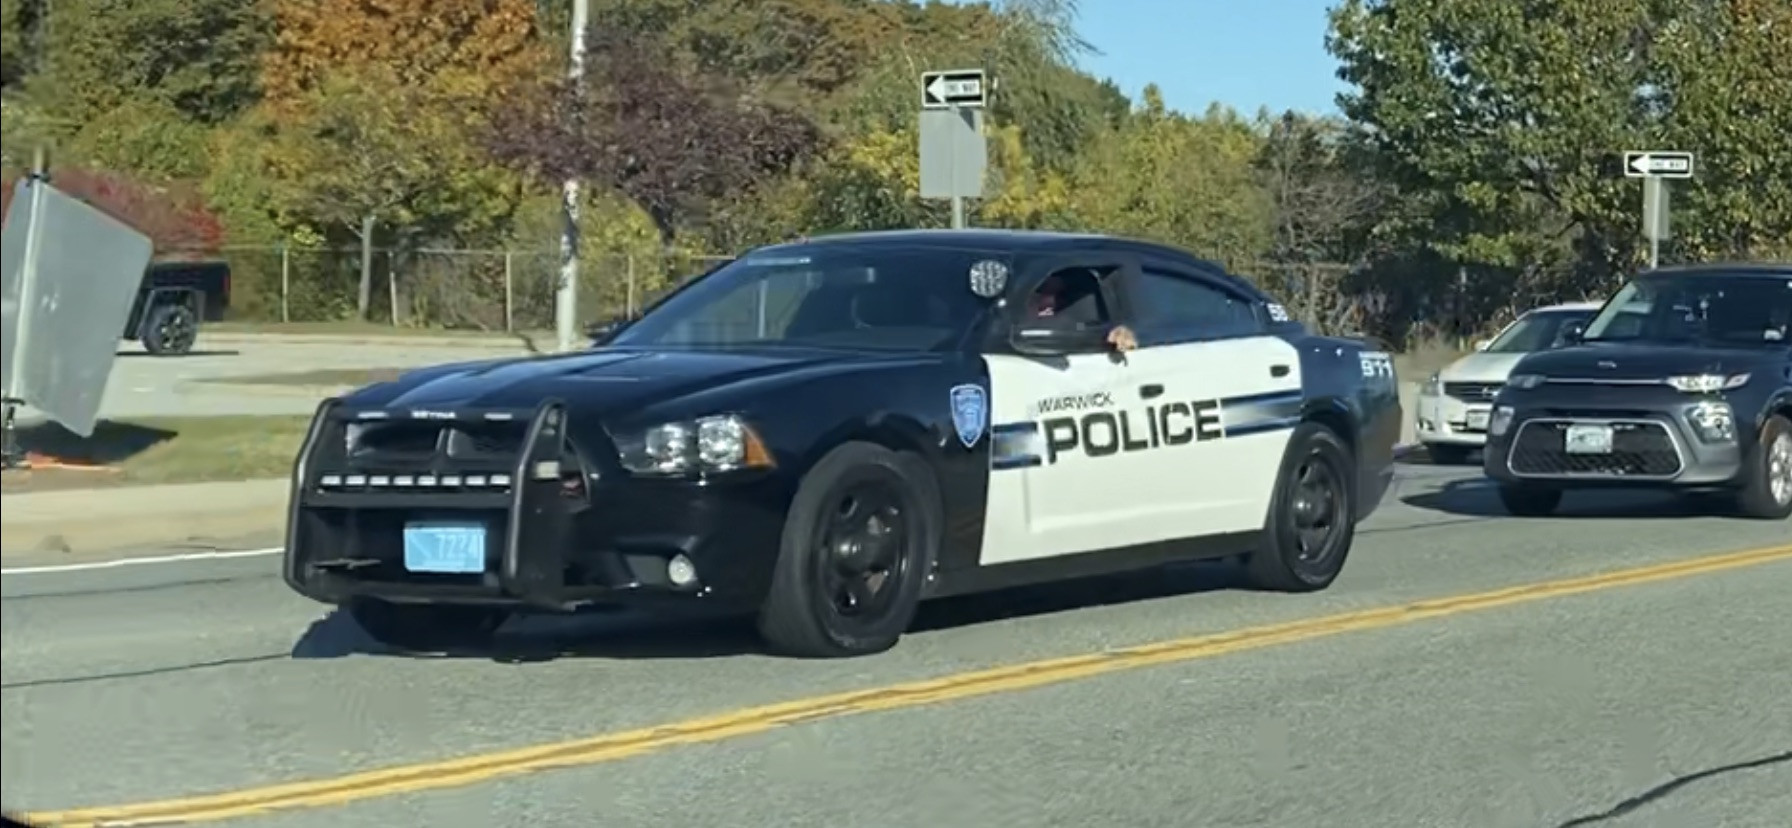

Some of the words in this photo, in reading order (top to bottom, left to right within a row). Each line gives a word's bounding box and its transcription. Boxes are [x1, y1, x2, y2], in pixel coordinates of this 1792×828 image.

[1361, 359, 1393, 378] 911
[1038, 391, 1114, 413] WARWICK
[1043, 399, 1222, 464] POLICE
